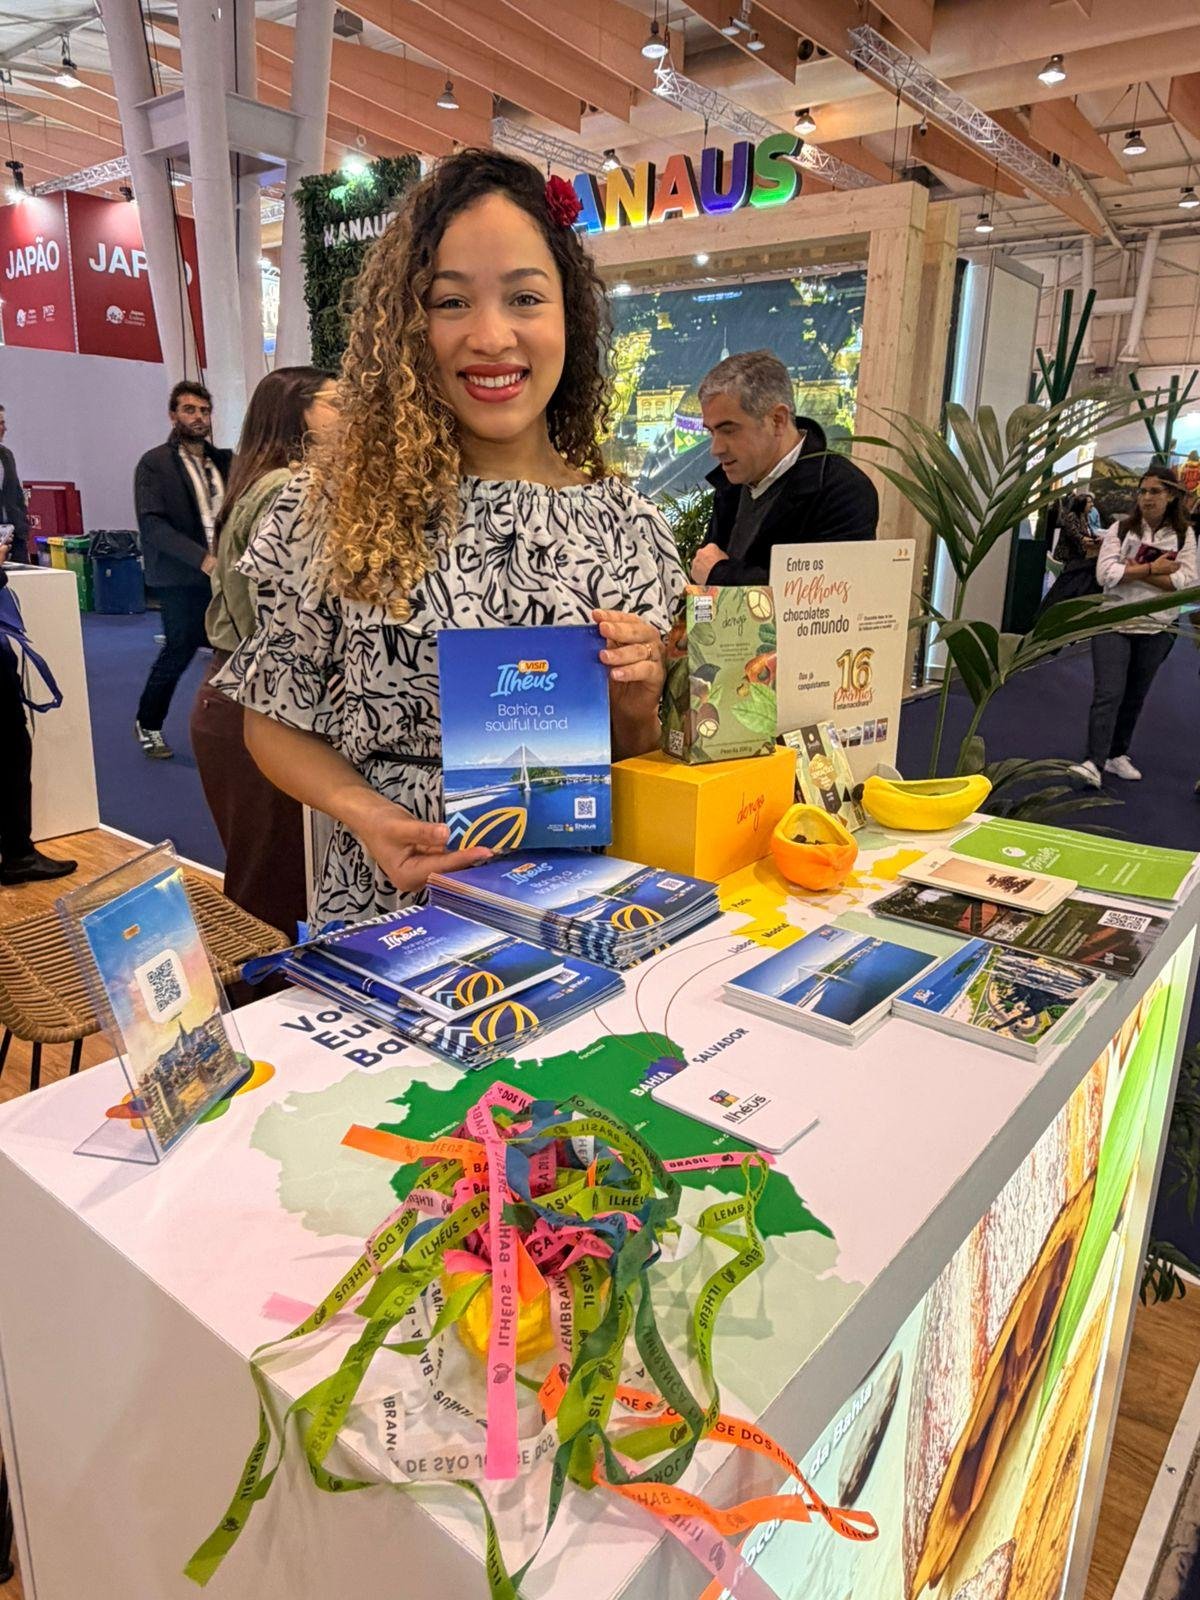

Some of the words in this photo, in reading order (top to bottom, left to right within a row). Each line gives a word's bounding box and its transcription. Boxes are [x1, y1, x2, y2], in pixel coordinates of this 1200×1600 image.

[571, 133, 803, 236] ANAUS
[6, 236, 60, 280] JAPÃO
[786, 557, 810, 572] Entre
[812, 559, 824, 571] os
[784, 574, 851, 605] Melhores
[783, 607, 830, 622] chocolates
[797, 623, 809, 637] do
[810, 614, 850, 636] mundo
[524, 661, 547, 671] VISIT
[836, 646, 875, 691] 16
[485, 719, 530, 732] soulful
[533, 717, 568, 730] Land
[498, 704, 541, 717] Bahia,
[544, 705, 554, 715] a
[692, 1027, 750, 1064] SALVADOR
[630, 1070, 672, 1097] BAHIA
[722, 1094, 767, 1123] Ilhéus
[669, 1157, 709, 1168] BRASIL
[420, 1221, 460, 1259] ILHÉUS
[334, 1259, 372, 1302] ILHÉUS
[699, 1284, 722, 1330] ILHÉUS
[433, 1390, 474, 1418] ILHÉUS
[741, 1428, 773, 1450] DOS
[809, 1443, 832, 1479] da
[833, 1383, 874, 1446] Bahia
